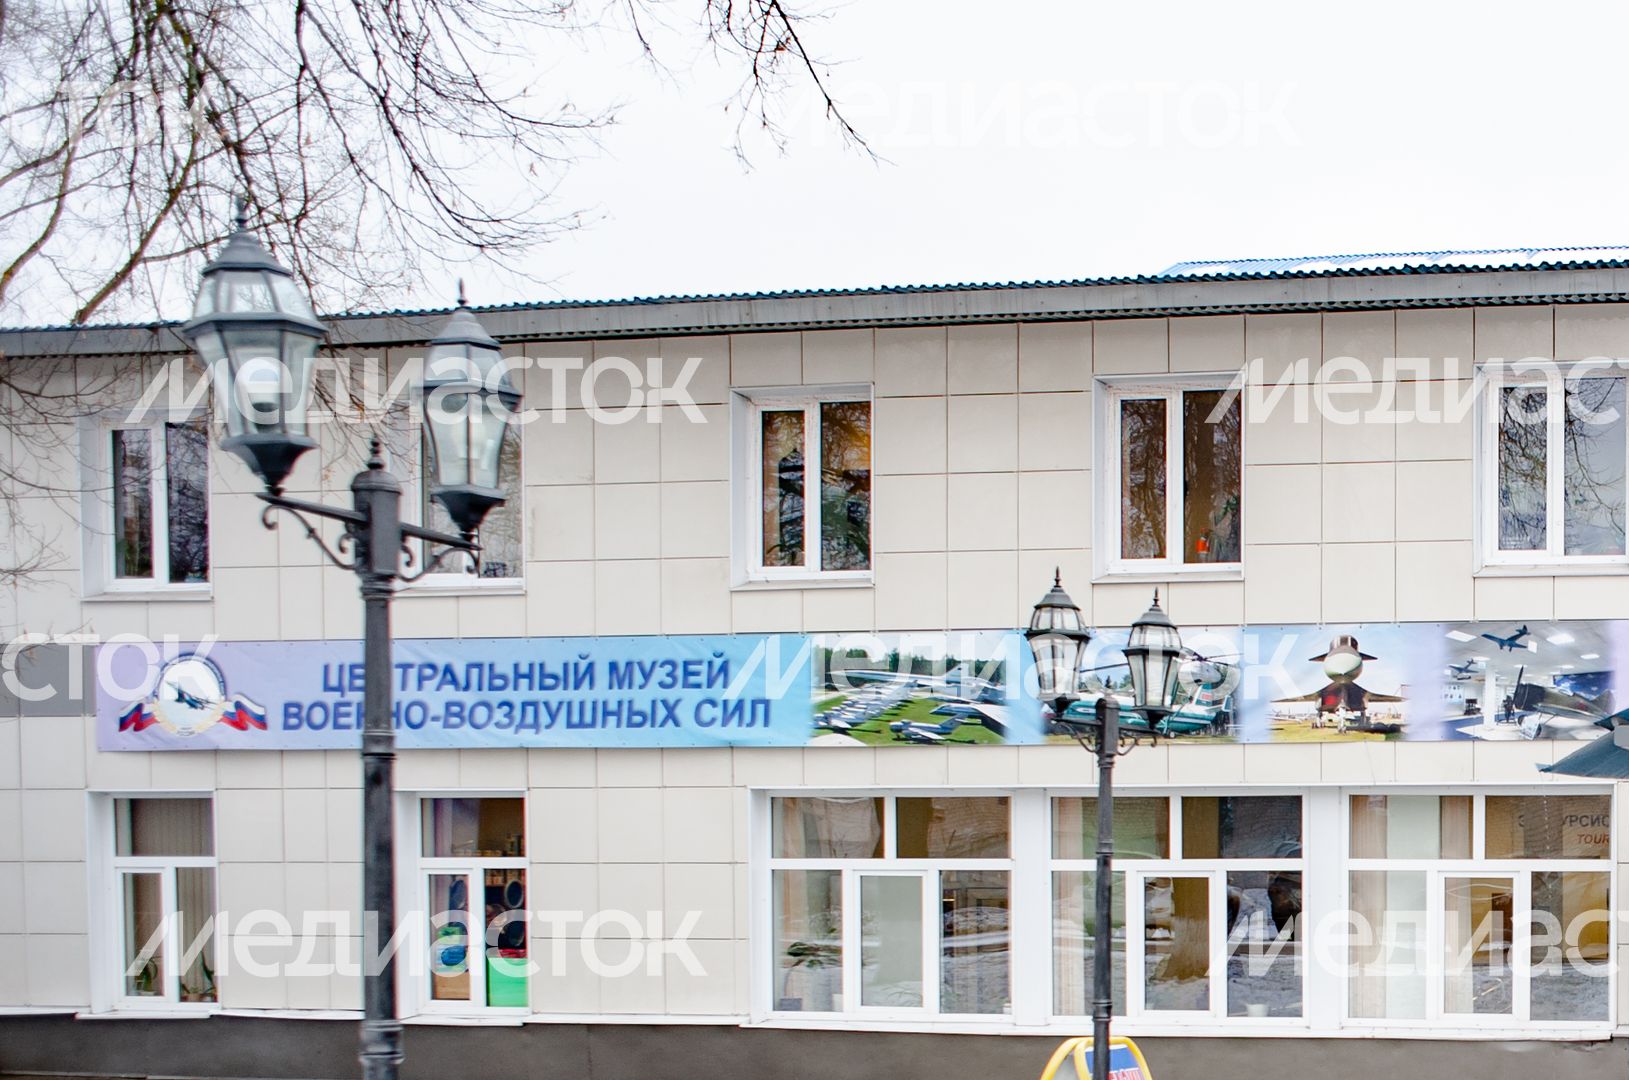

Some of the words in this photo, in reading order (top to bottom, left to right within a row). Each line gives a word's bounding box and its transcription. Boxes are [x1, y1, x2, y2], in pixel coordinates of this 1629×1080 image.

[322, 653, 596, 697] ЦЕТРАЛЬНЫЙ
[608, 652, 731, 690] МУЗЕЙ
[694, 698, 771, 729] СИЛ
